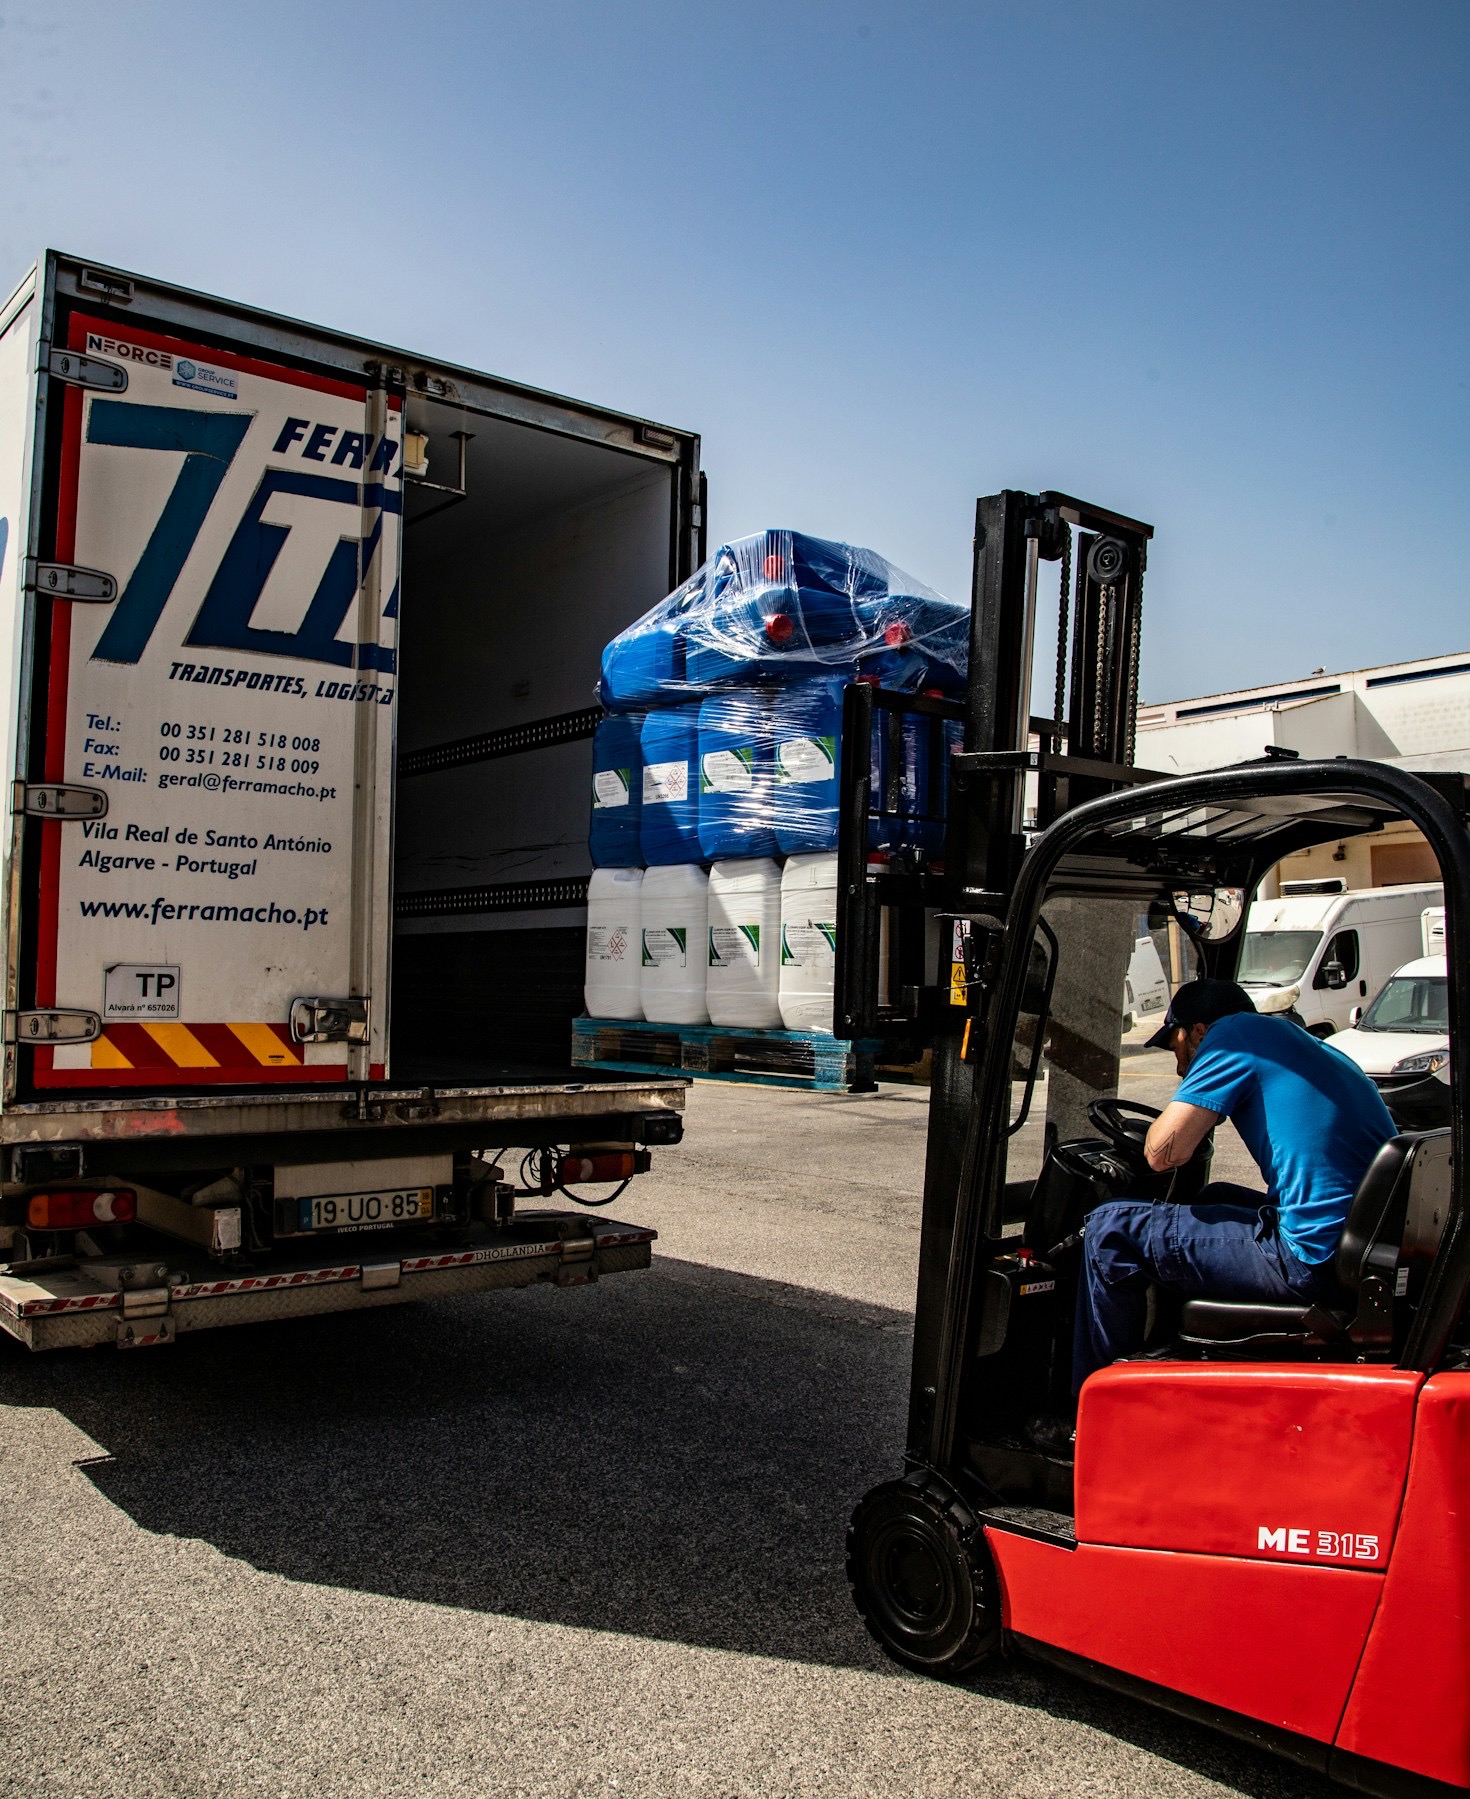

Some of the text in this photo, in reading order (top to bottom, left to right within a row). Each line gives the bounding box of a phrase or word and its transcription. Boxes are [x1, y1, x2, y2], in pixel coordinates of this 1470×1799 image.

[88, 335, 172, 368] NFORCE
[197, 372, 235, 388] SERVICE
[198, 367, 215, 375] GROUP
[272, 416, 402, 479] FERR
[169, 661, 308, 698] TRANSPORTES,
[85, 713, 320, 752] Tel.: 00 351 281 518 008
[83, 738, 319, 775] Fax: 00 351 281 518 009
[82, 762, 337, 802] E-Mail: geral@ferramacho.pt
[82, 821, 332, 853] Vila Real de Santo António
[79, 850, 156, 873] Algarve
[176, 855, 257, 879] Portugal
[80, 897, 328, 930] www.ferramacho.pt
[136, 973, 175, 997] TP
[108, 1004, 135, 1012] Alvará
[147, 1004, 176, 1012] 657026
[359, 1222, 394, 1232] PORTUGAL
[475, 1244, 545, 1260] DHOLLANDIA
[1257, 1526, 1379, 1560] ME 315
